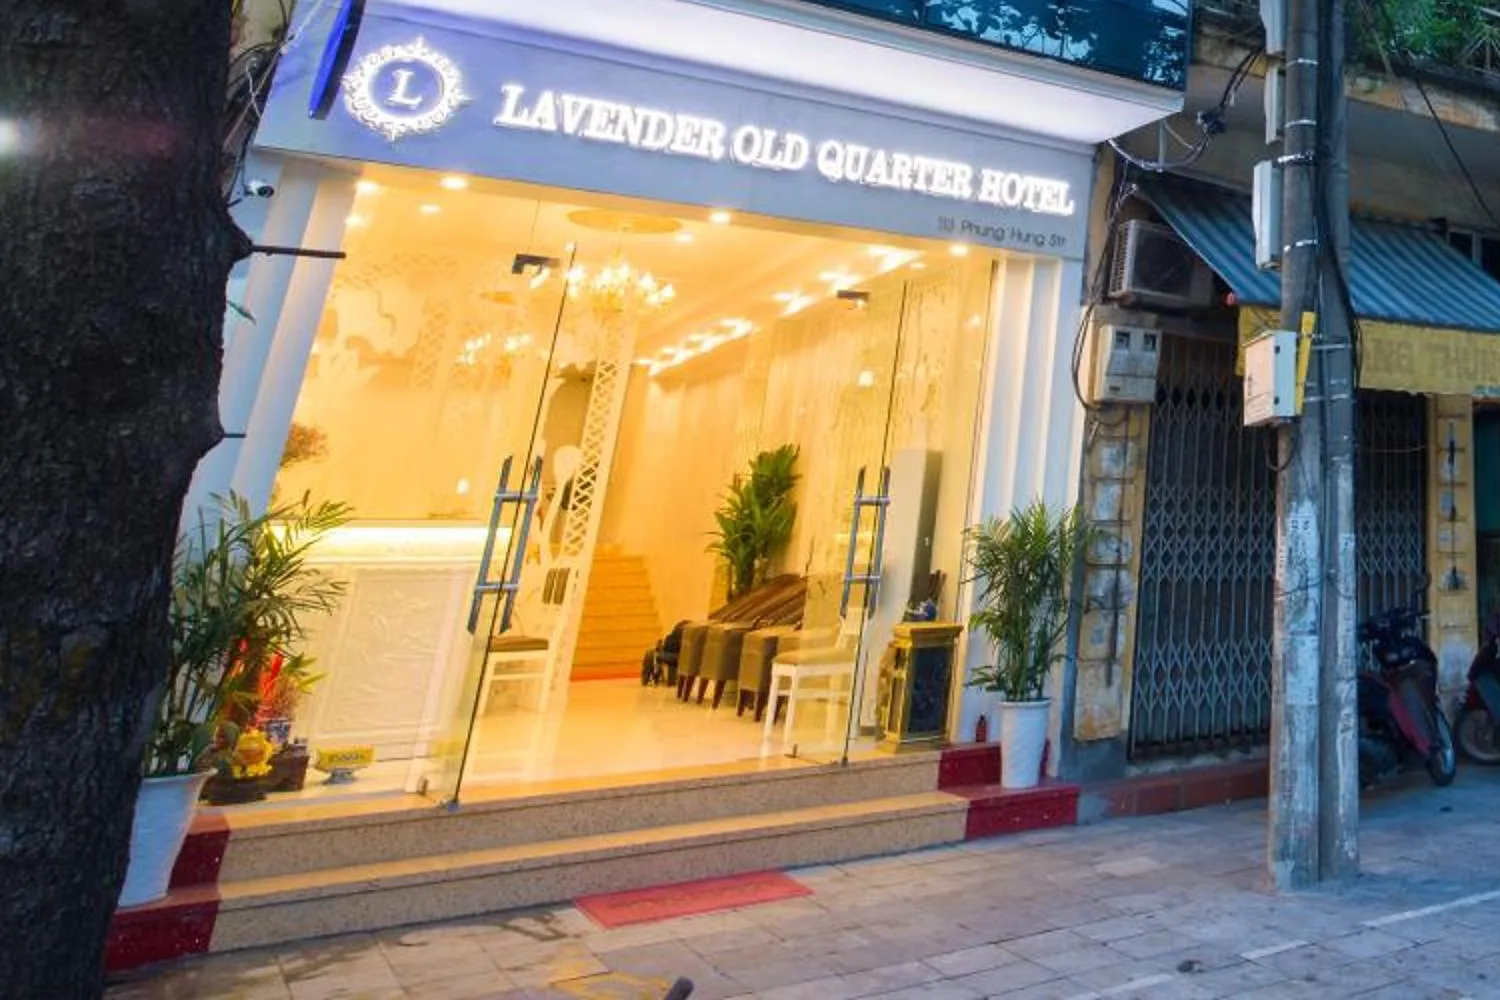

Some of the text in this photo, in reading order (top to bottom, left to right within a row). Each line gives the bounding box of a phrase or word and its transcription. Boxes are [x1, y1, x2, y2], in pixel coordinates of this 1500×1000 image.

[390, 68, 423, 107] L
[494, 83, 1075, 216] LAVENDER OLD QUARTER HOTEL
